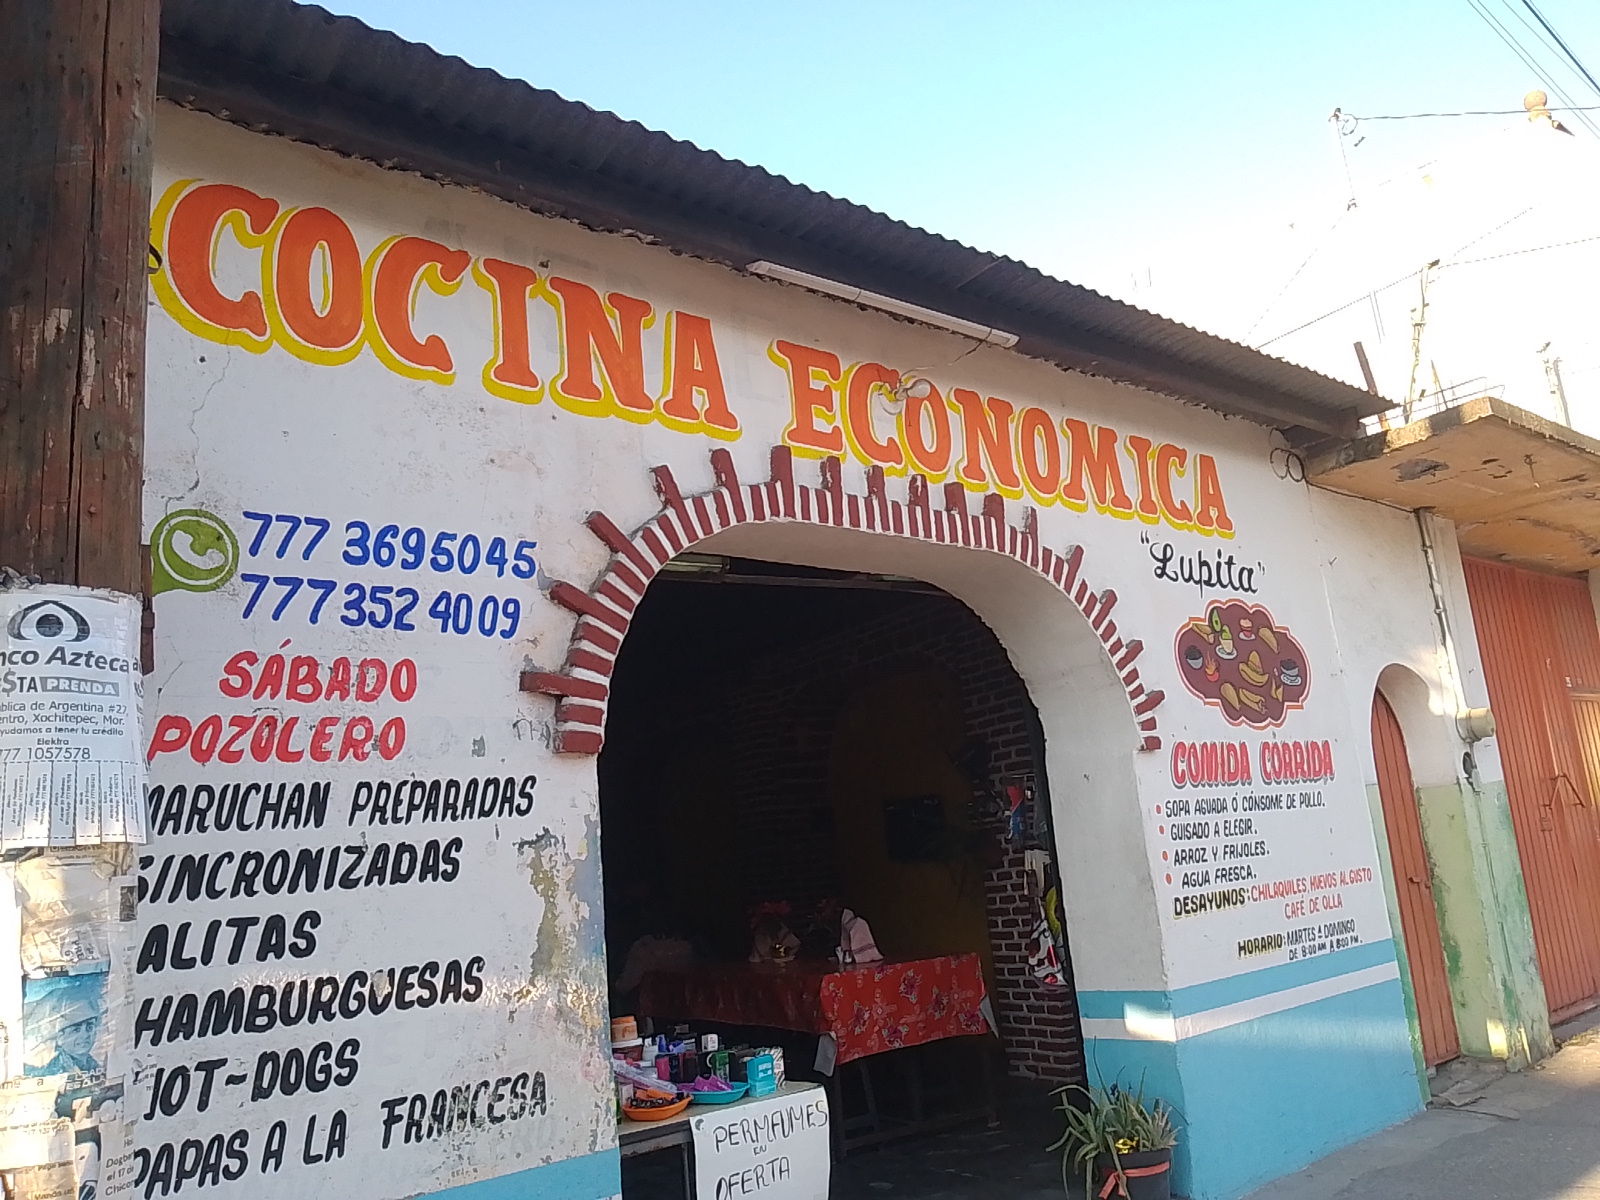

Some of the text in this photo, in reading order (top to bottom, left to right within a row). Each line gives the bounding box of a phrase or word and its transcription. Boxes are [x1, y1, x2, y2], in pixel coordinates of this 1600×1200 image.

[150, 179, 1235, 539] COCINA ECONOMICA
[243, 511, 537, 579] 777 3695045
[44, 646, 129, 673] Azteca
[219, 639, 417, 703] SÁBADO
[46, 678, 116, 695] PRENDA
[0, 702, 26, 712] blica
[30, 701, 45, 711] de
[49, 701, 104, 713] Argentina
[32, 713, 99, 726] Xochitepec,
[103, 715, 125, 726] Mor.
[55, 726, 79, 734] tener
[147, 715, 406, 763] POZOLERO
[27, 747, 91, 760] 1057578
[1170, 739, 1334, 789] COMIDA CORRIDA
[349, 775, 537, 827] PREPARADAS
[1165, 799, 1190, 818] SOPA
[1194, 797, 1228, 816] AGUADA
[1286, 793, 1297, 809] DE
[1299, 791, 1325, 809] POLLO.
[1170, 818, 1257, 841] GUISADO A ELEGIR.
[137, 836, 463, 905] SINCRONIZADAS
[1174, 840, 1270, 866] ARROZ Y FRIJOLES.
[1174, 886, 1250, 918] DESAYUNOS:
[1310, 872, 1337, 890] HUEVOS
[1182, 864, 1257, 889] AGUA FRESCA.
[1284, 893, 1343, 919] CAFÉ DE OLLA
[137, 911, 321, 974] ALITAS
[1237, 933, 1286, 958] HORARIO:
[1287, 927, 1316, 947] MARTES
[1324, 919, 1355, 939] DOMINGO
[1288, 948, 1298, 960] DE
[134, 955, 486, 1050] HAMBURGUESAS
[261, 1120, 287, 1174] A
[303, 1109, 346, 1165] LA
[381, 1070, 547, 1150] FRANCESA
[713, 1100, 827, 1153] PERMFUMES
[753, 1144, 767, 1156] EN
[716, 1157, 790, 1200] OFERTA
